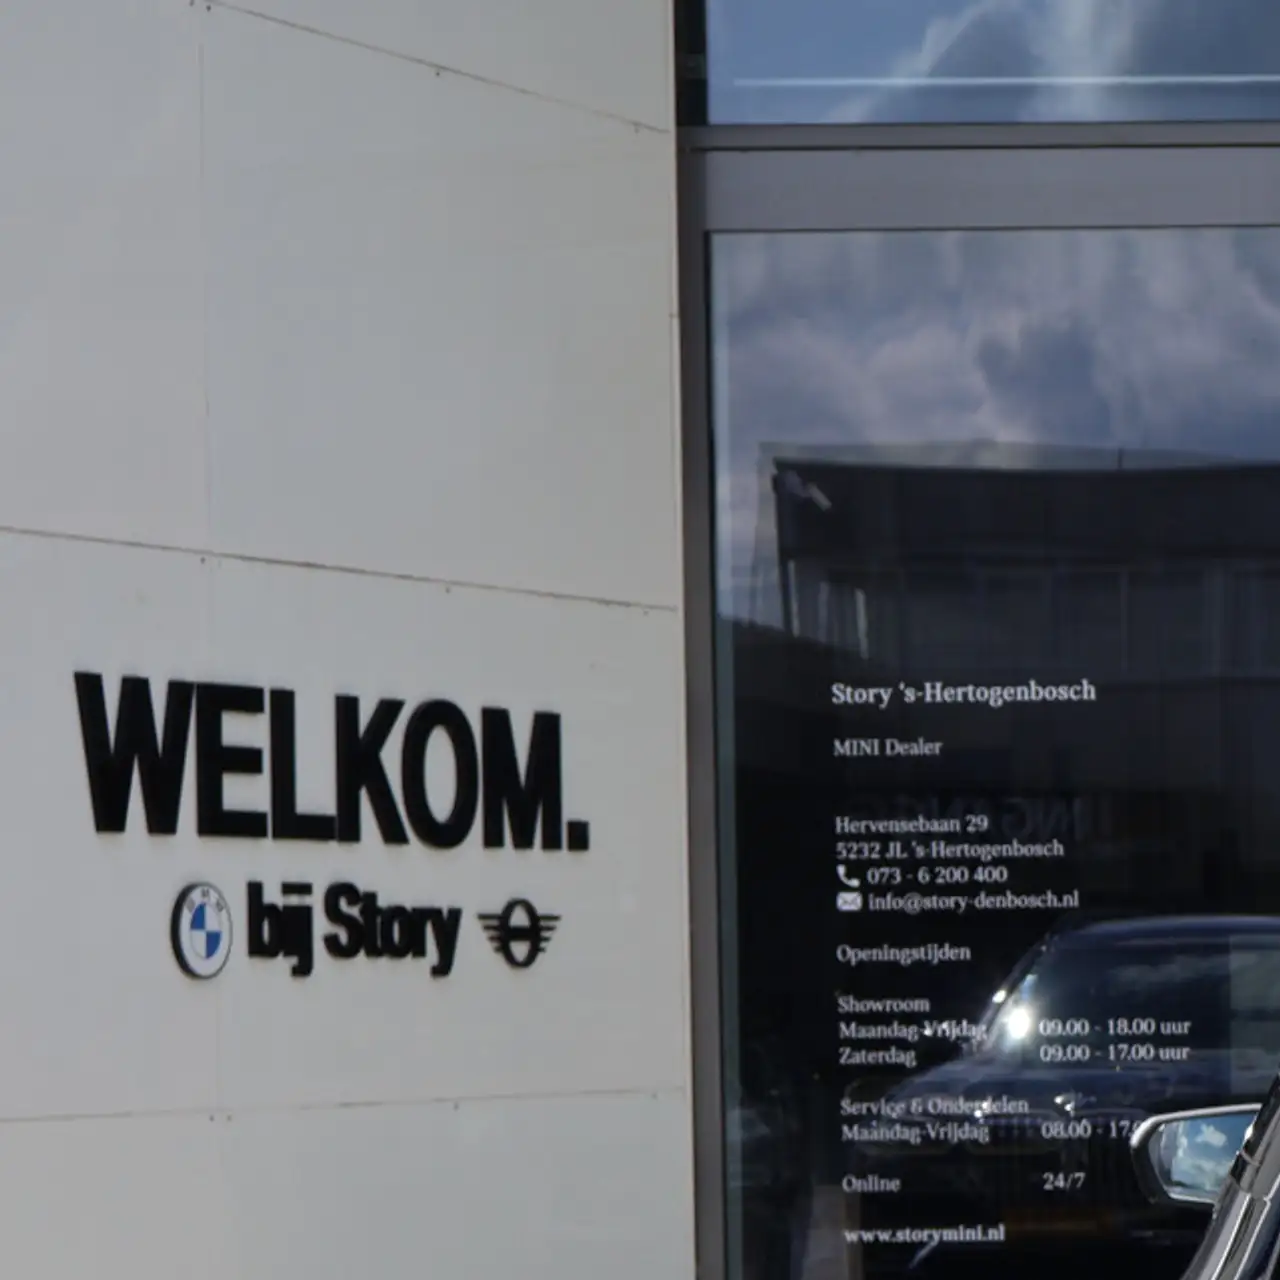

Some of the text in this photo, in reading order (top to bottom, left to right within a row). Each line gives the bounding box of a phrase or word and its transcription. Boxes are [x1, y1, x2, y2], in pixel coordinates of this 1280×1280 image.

[831, 678, 1097, 709] Story 's-Hertogenbosch
[834, 738, 943, 757] MINI Dealer
[73, 671, 590, 851] WELKOM.
[835, 815, 988, 834] Hervensebaan 29
[836, 839, 1064, 861] 5232 JL 's-Hertogenbosch
[867, 868, 901, 884] 073
[918, 867, 930, 884] 6
[935, 867, 969, 884] 200
[974, 866, 1008, 883] 400
[868, 889, 1079, 915] info@story-denbosch.nl
[247, 881, 462, 978] bij Story
[837, 944, 971, 966] Openingstijden
[837, 996, 930, 1013] Showroom
[1039, 1020, 1089, 1036] 09.00
[1108, 1019, 1156, 1035] 18.00
[1160, 1021, 1191, 1035] uur
[839, 1047, 917, 1067] Zaterdag
[1040, 1046, 1090, 1062] 09.00
[1109, 1045, 1154, 1061] 17.00
[1159, 1047, 1191, 1061] uur
[840, 1098, 906, 1117] Service
[910, 1098, 922, 1114] &
[842, 1123, 989, 1143] Maandag-Vrijdag
[1042, 1122, 1091, 1139] 08.00
[842, 1172, 1085, 1193] Online 24/7
[844, 1224, 1005, 1243] www.storymini.nl
